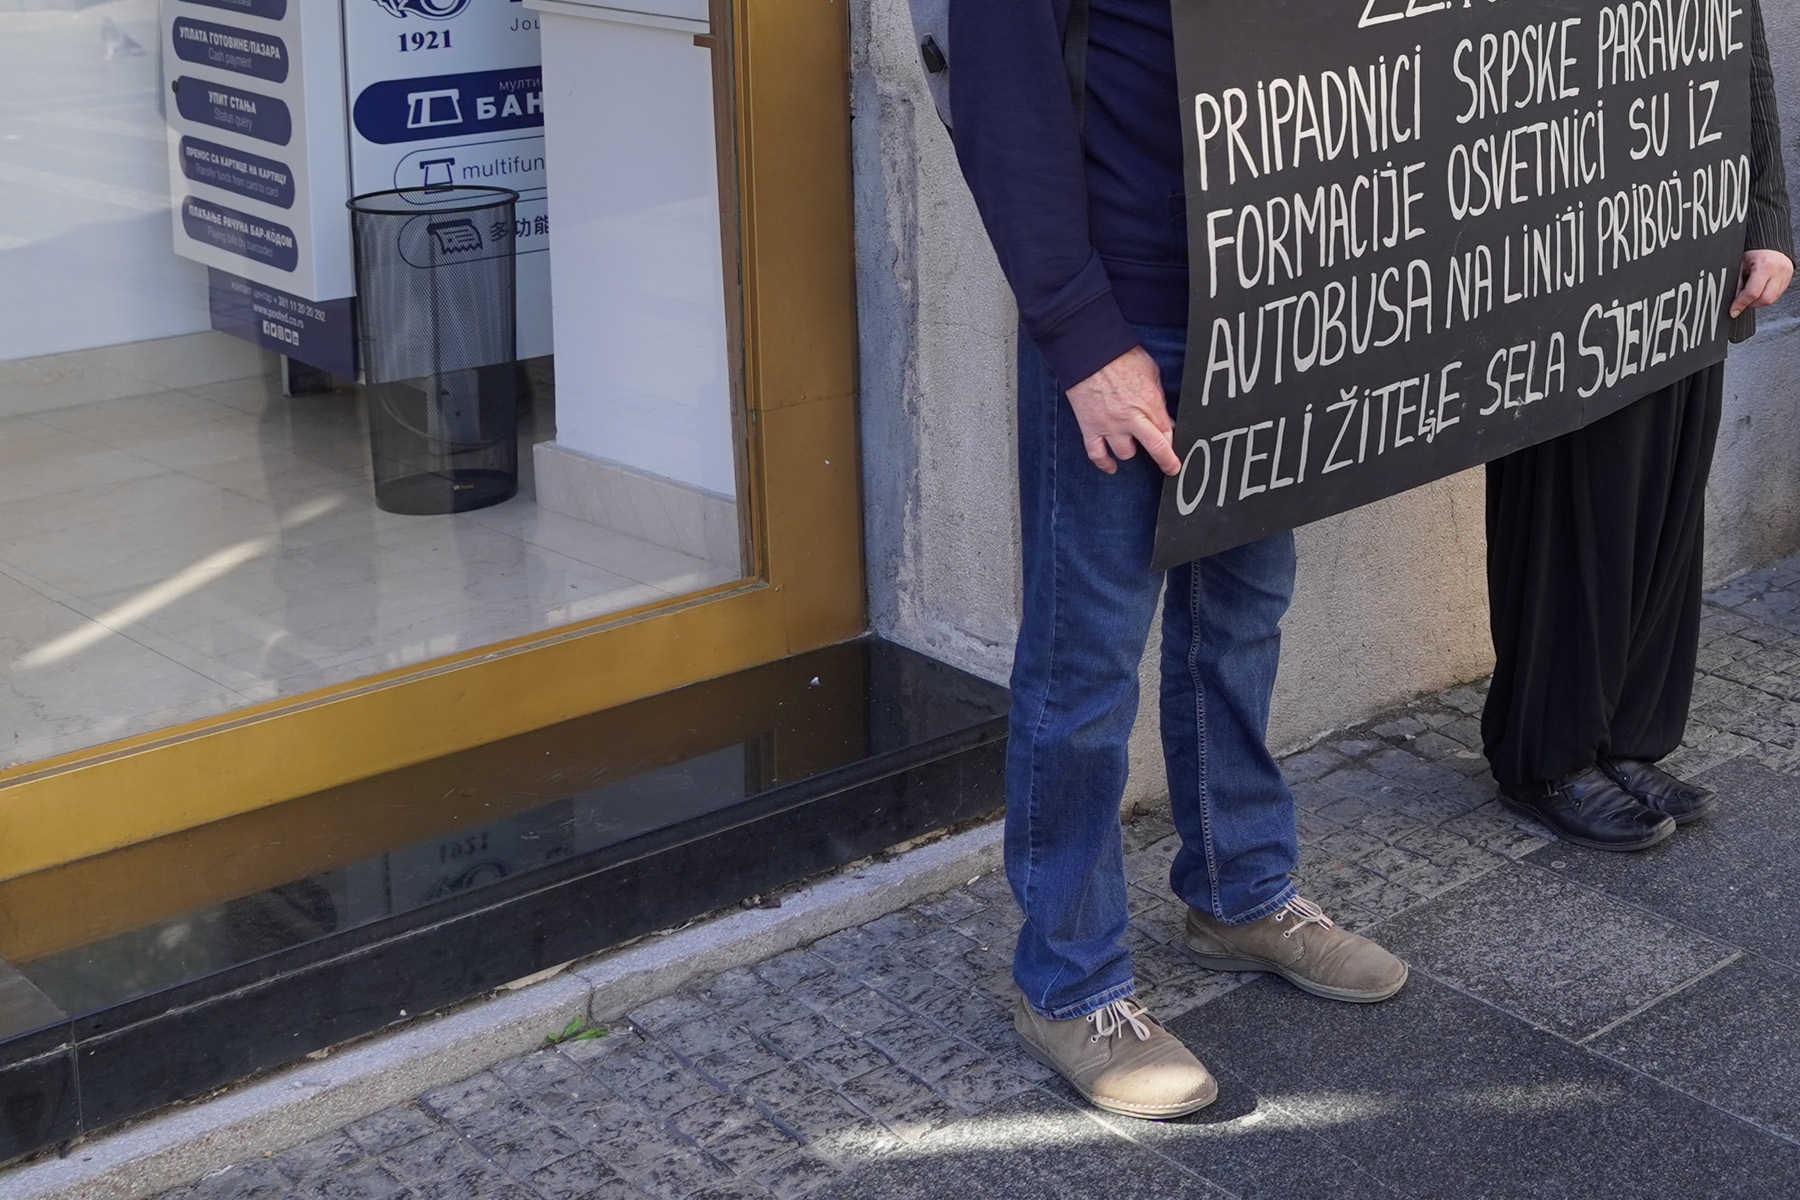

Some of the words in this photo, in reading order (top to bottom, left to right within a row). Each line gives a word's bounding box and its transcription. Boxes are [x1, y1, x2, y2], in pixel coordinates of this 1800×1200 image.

[180, 26, 208, 44] УПЛАТА
[398, 29, 453, 53] 1921
[208, 47, 224, 61] Cash
[225, 53, 252, 69] payment
[208, 91, 228, 106] УПИТ
[1194, 44, 1423, 190] PRIPADNICI
[1453, 17, 1582, 125] SRPSKE
[214, 107, 234, 124] Status
[235, 116, 253, 131] query
[211, 154, 219, 164] СА
[1206, 161, 1427, 298] FORMACIJE
[1447, 100, 1606, 221] OSVETNICI
[1629, 92, 1668, 161] SU
[1687, 79, 1723, 150] IZ
[1201, 259, 1433, 406] AUTOBUSA
[1446, 254, 1492, 330] NA
[1503, 205, 1586, 304] LINIJI
[1597, 154, 1750, 277] PRIBOJ-RUDO
[1176, 405, 1311, 515] OTELI
[1479, 331, 1566, 416] SELA
[1577, 267, 1729, 399] SJEVERIN
